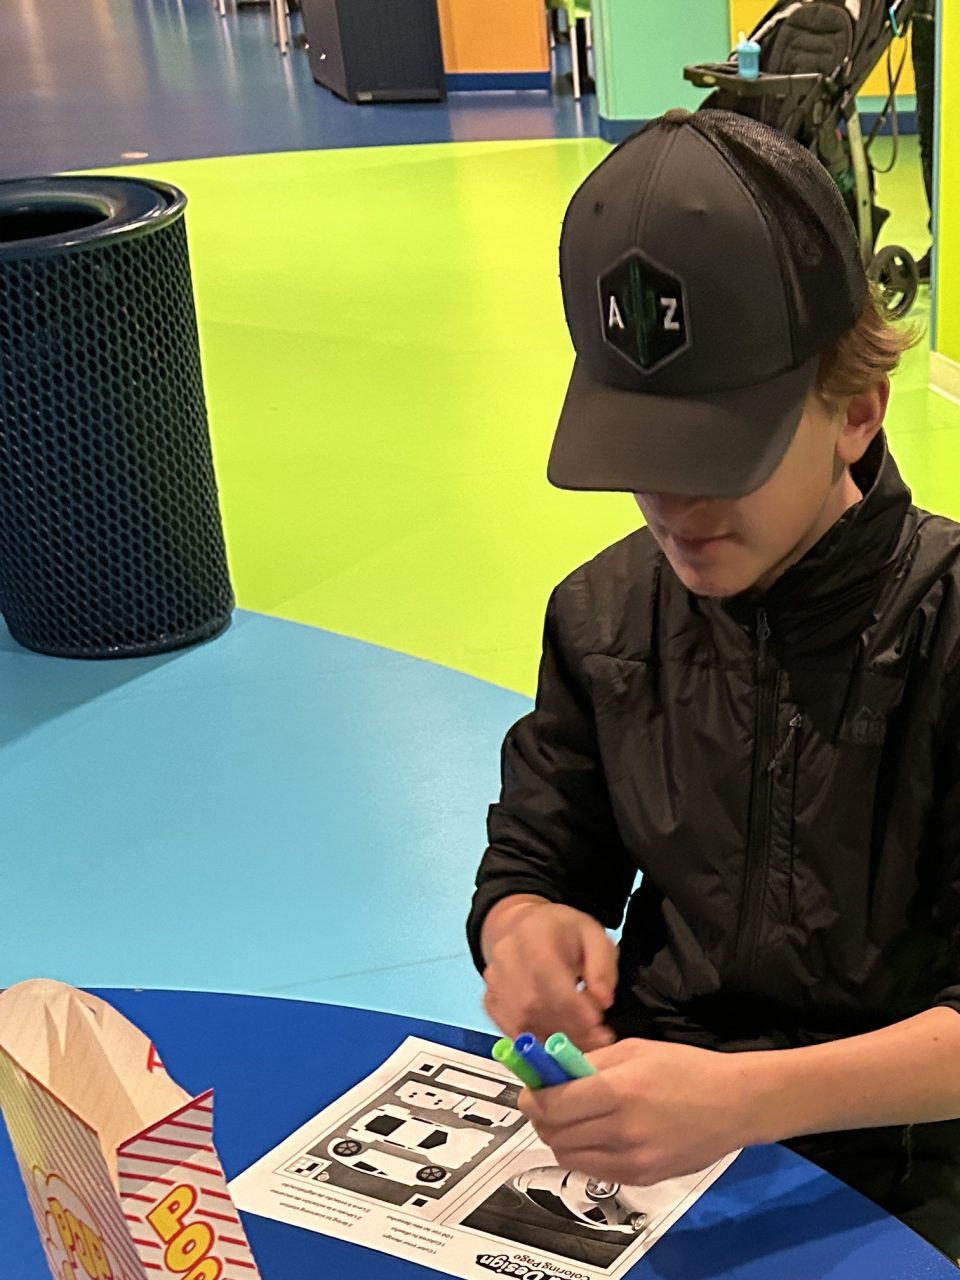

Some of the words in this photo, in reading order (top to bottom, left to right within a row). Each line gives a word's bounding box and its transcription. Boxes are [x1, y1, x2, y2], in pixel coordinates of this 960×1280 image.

[608, 295, 625, 329] A
[660, 297, 680, 330] Z
[512, 1254, 541, 1267] Page
